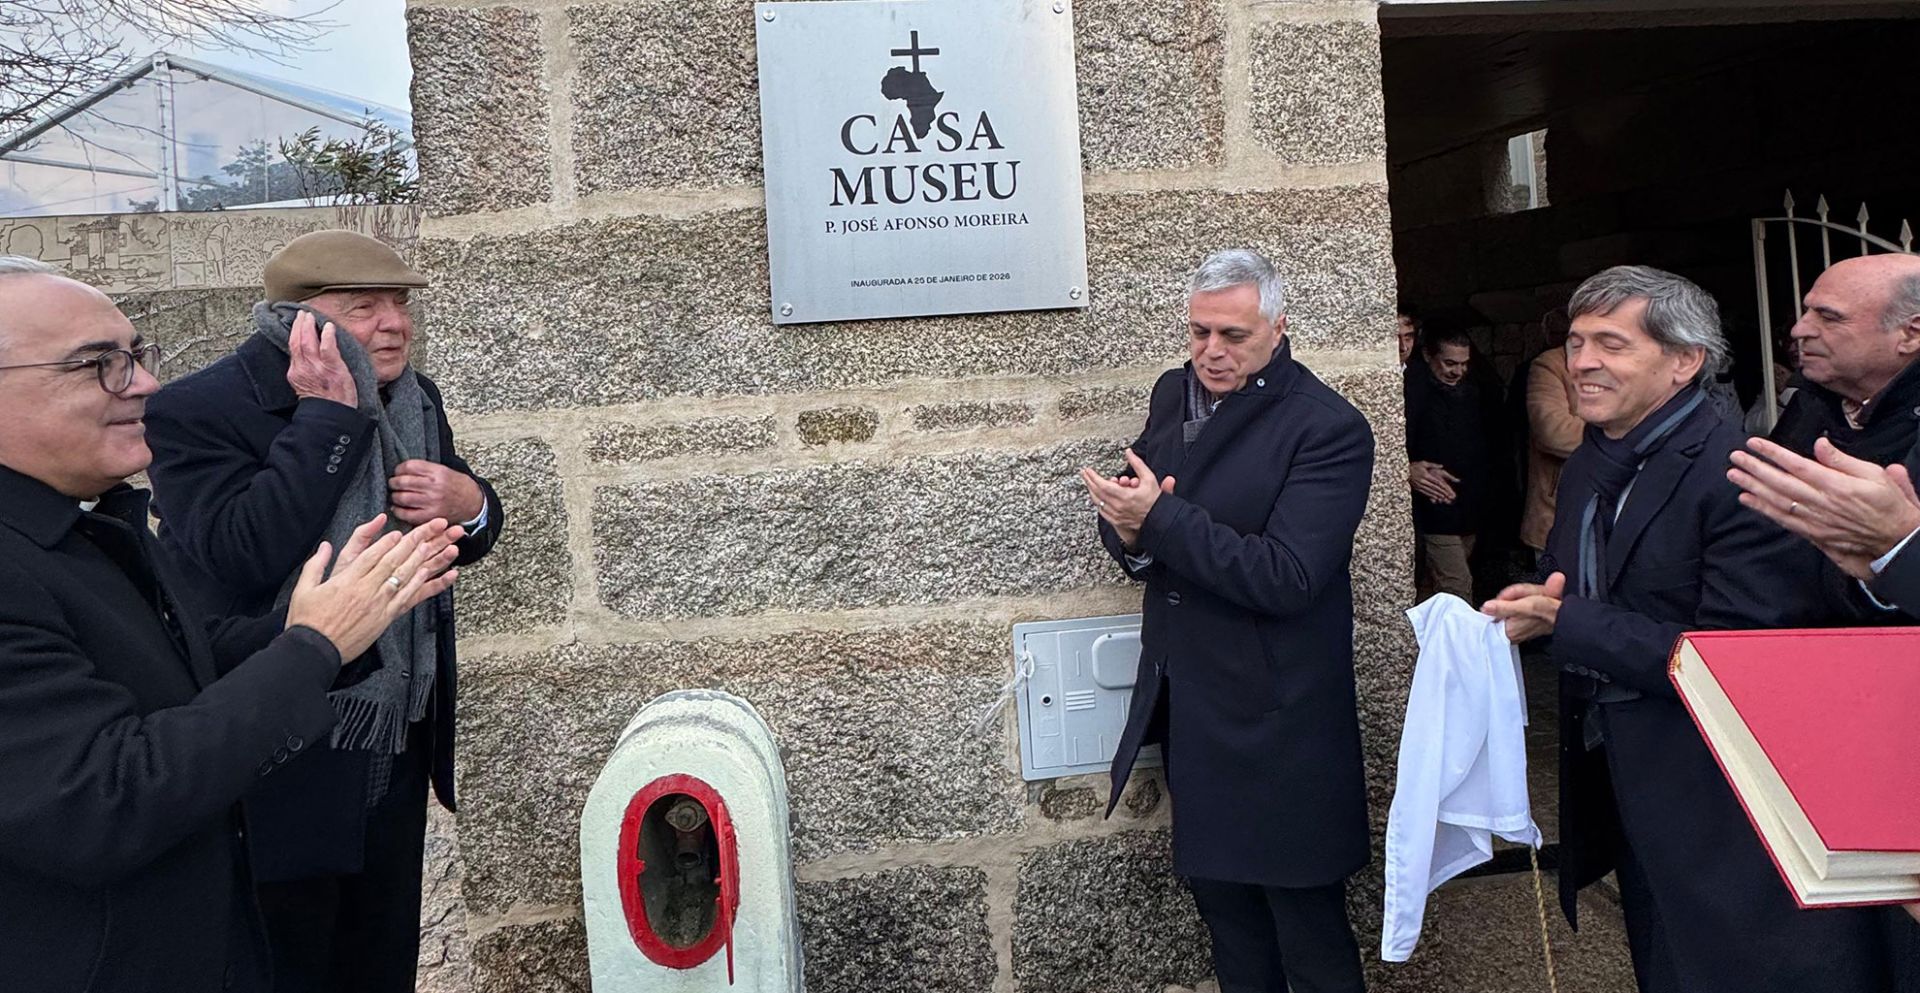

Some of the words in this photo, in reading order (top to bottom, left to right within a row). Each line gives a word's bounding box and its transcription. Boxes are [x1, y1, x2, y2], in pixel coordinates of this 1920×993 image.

[841, 111, 1005, 155] CASA
[829, 161, 1021, 206] MUSEU
[825, 221, 837, 233] P.
[842, 216, 879, 235] JOSÉ
[883, 215, 949, 231] AFONSO
[954, 212, 1029, 228] MOREIRA
[850, 278, 906, 287] INAUGURADA
[926, 276, 938, 284] DE
[939, 274, 975, 283] JANEIRO
[976, 273, 988, 282] DE
